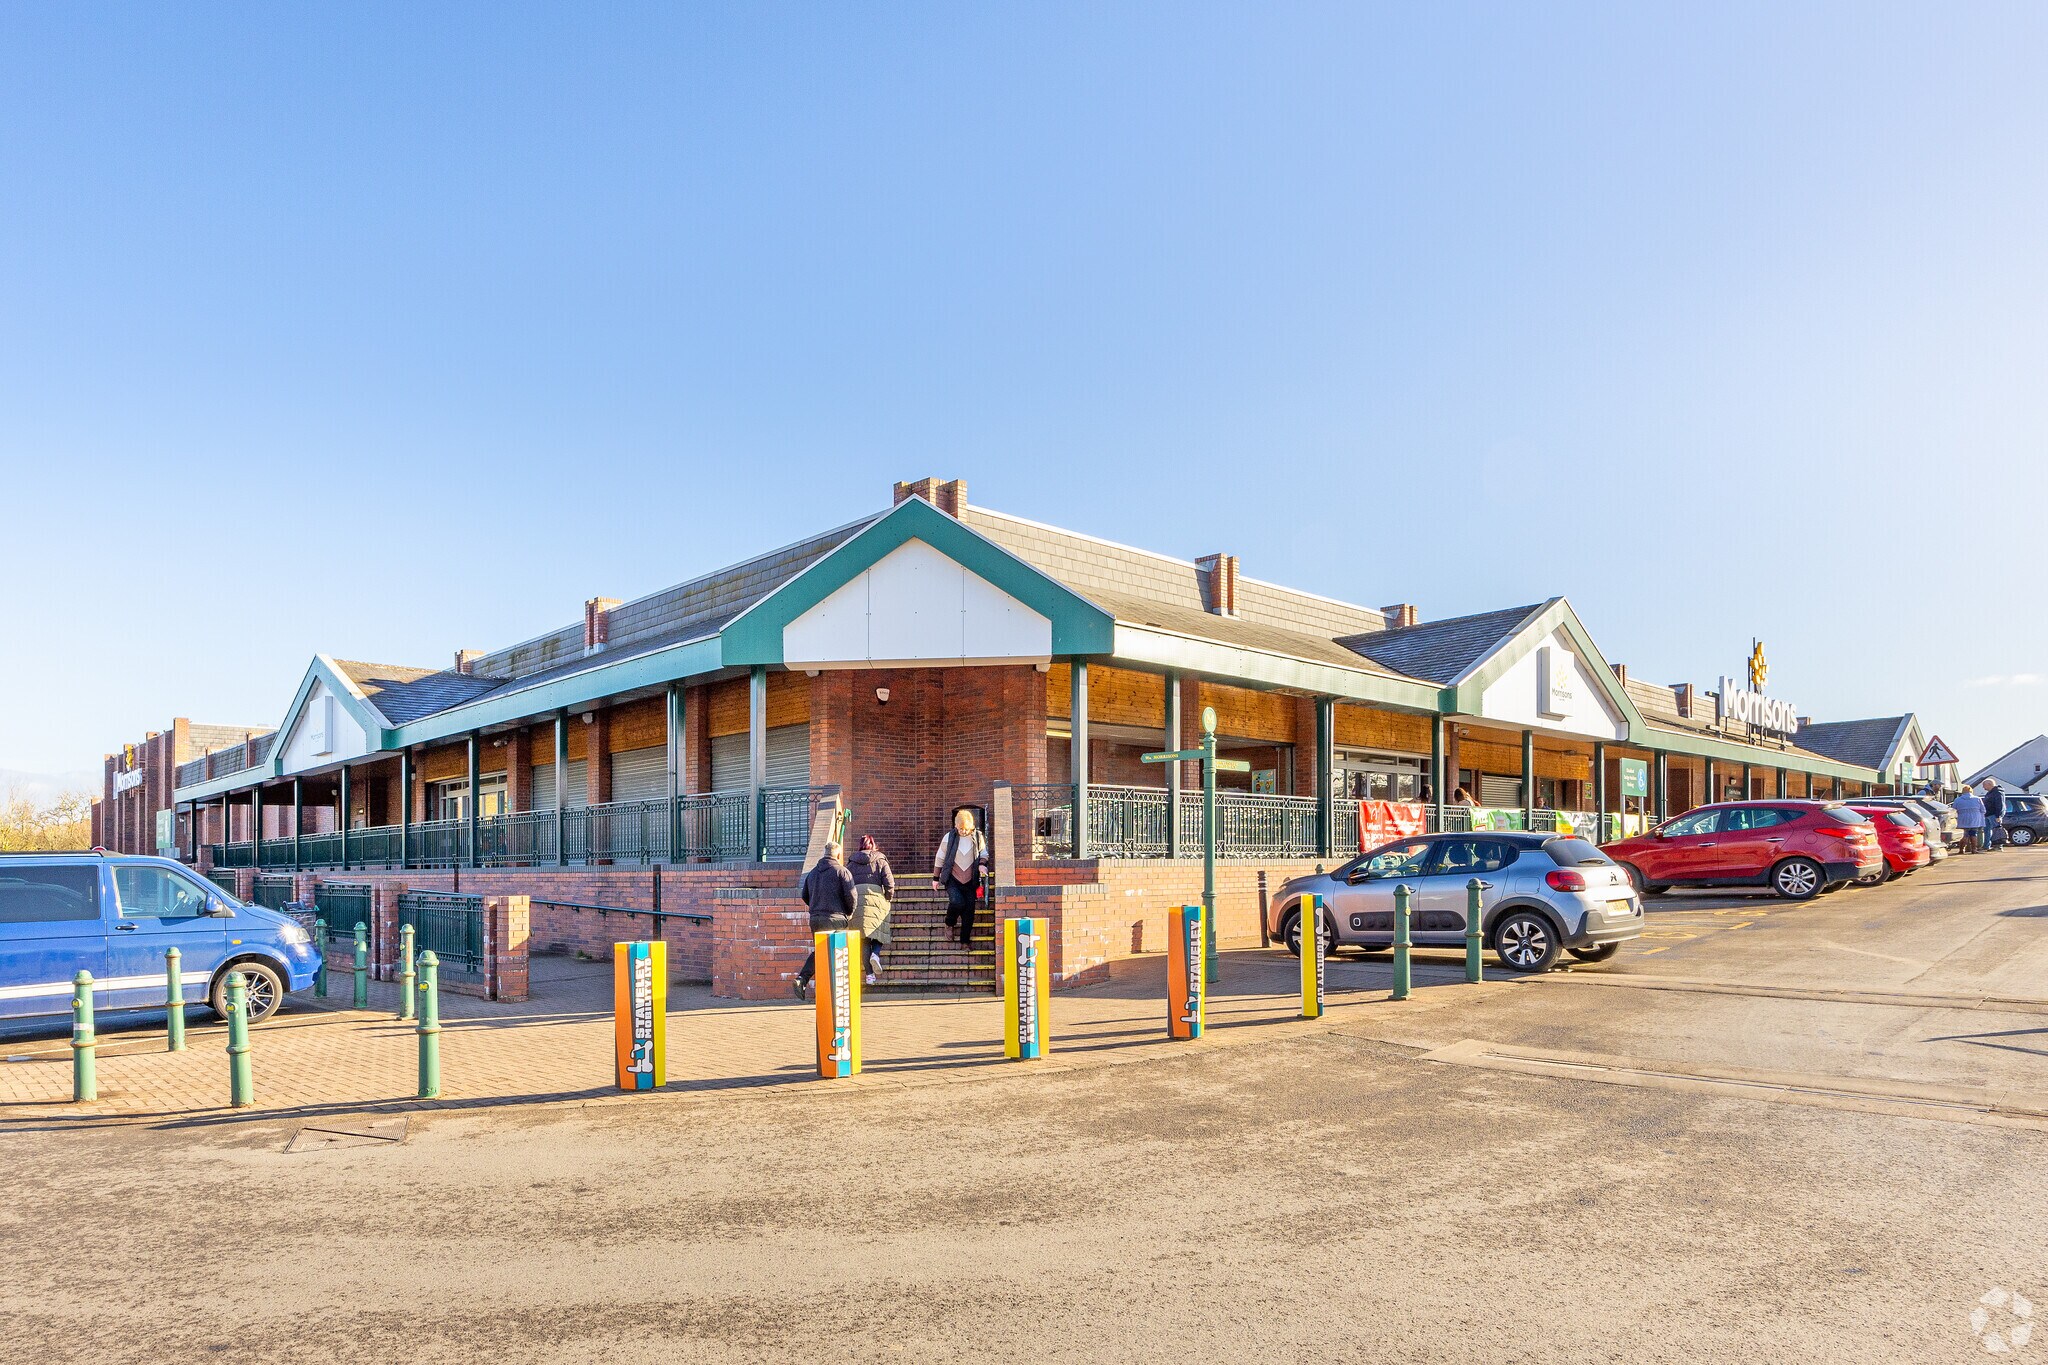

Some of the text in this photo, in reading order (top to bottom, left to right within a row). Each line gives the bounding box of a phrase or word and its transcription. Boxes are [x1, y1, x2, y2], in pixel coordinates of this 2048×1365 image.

[1552, 687, 1572, 700] Morrisons
[1719, 676, 1798, 734] Morrisons
[113, 768, 142, 800] Morrisons
[835, 948, 843, 1027] STAVELEY
[1190, 919, 1200, 992] STAVELEY
[635, 958, 645, 1039] STAVELEY
[1019, 966, 1027, 1043] MOBILITY LTD
[1027, 967, 1035, 1044] STAVELEY
